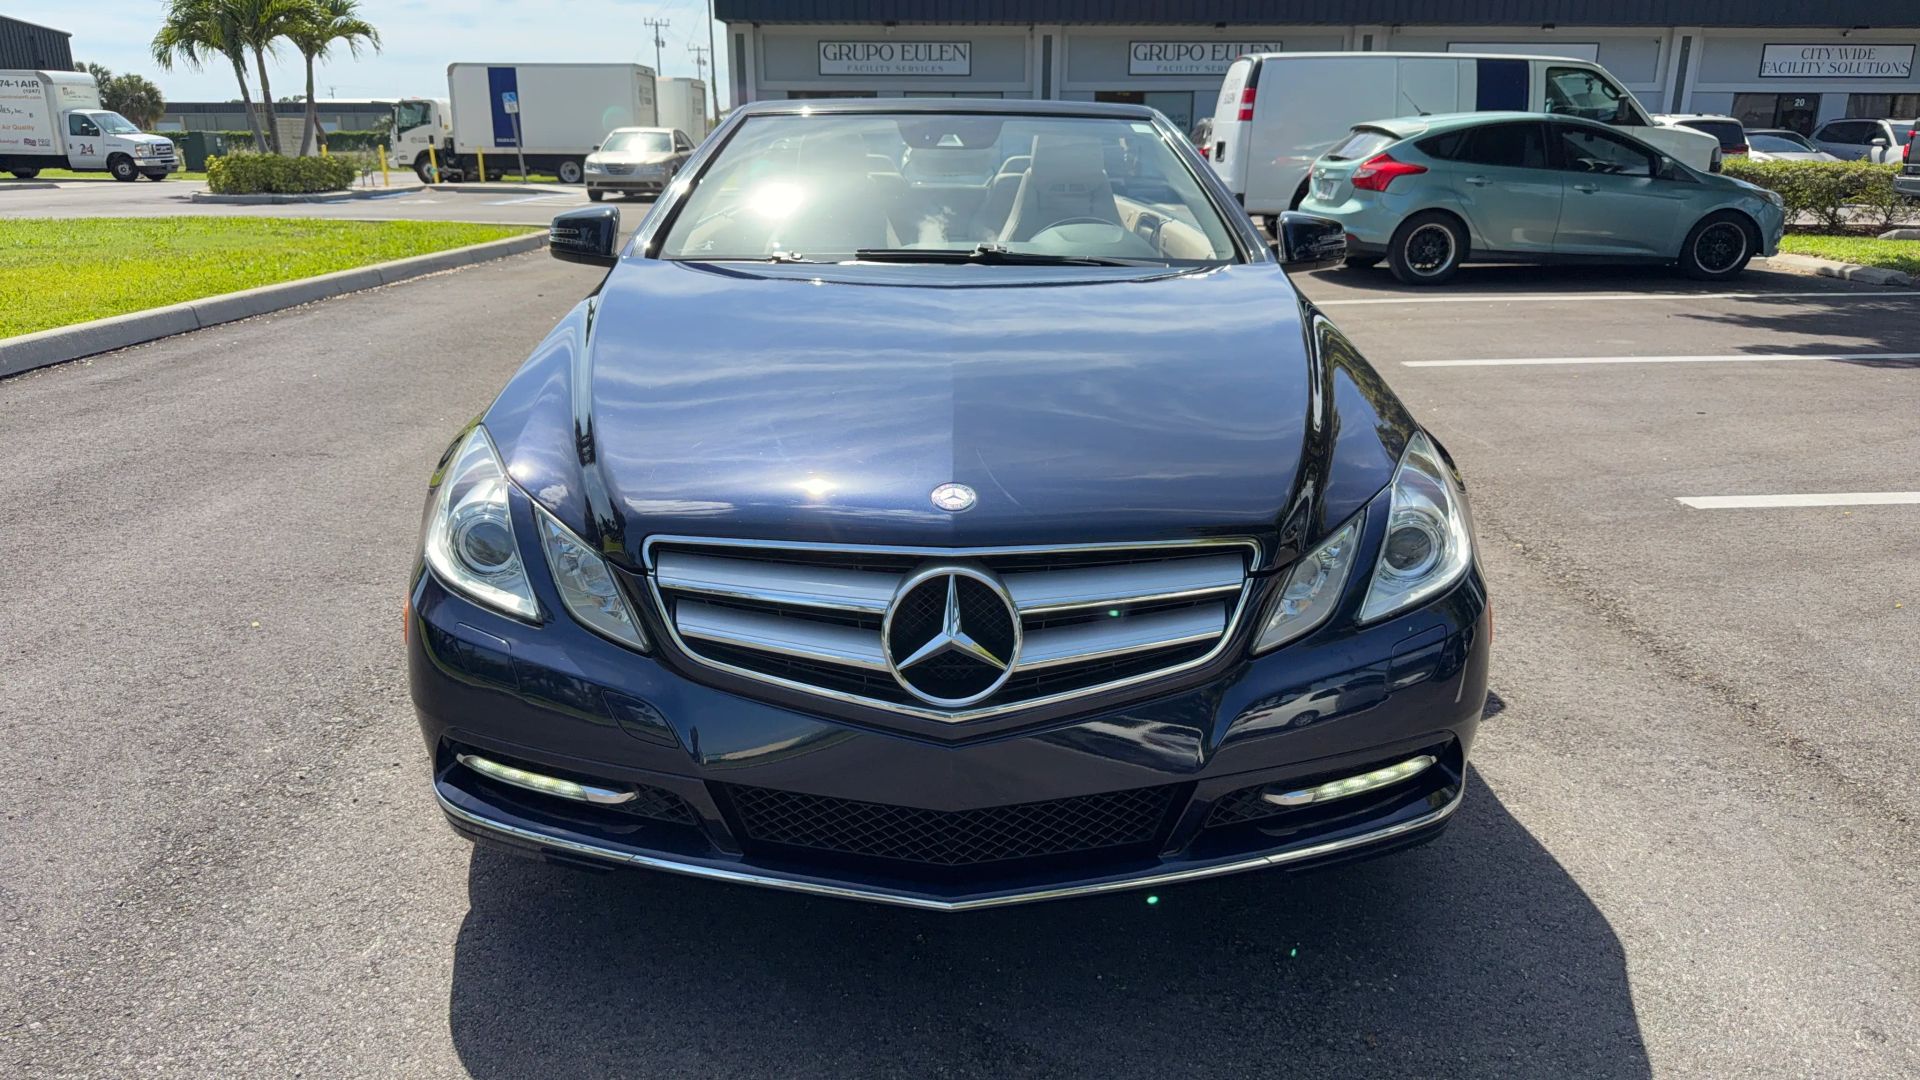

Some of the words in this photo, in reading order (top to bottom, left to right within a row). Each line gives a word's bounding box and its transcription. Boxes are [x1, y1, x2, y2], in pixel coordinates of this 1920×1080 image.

[823, 44, 894, 61] GRUPO
[900, 44, 967, 61] EULEN
[1133, 44, 1205, 61] GRUPO
[1801, 48, 1834, 60] CITY
[1838, 48, 1877, 60] WIDE
[847, 65, 891, 73] FACILITY
[895, 65, 944, 73] SERVICES
[1156, 65, 1200, 73] FACILITY
[1762, 62, 1824, 74] FACILITY
[1827, 62, 1910, 74] SOLUTIONS
[1794, 98, 1805, 107] 20
[80, 143, 95, 155] 24
